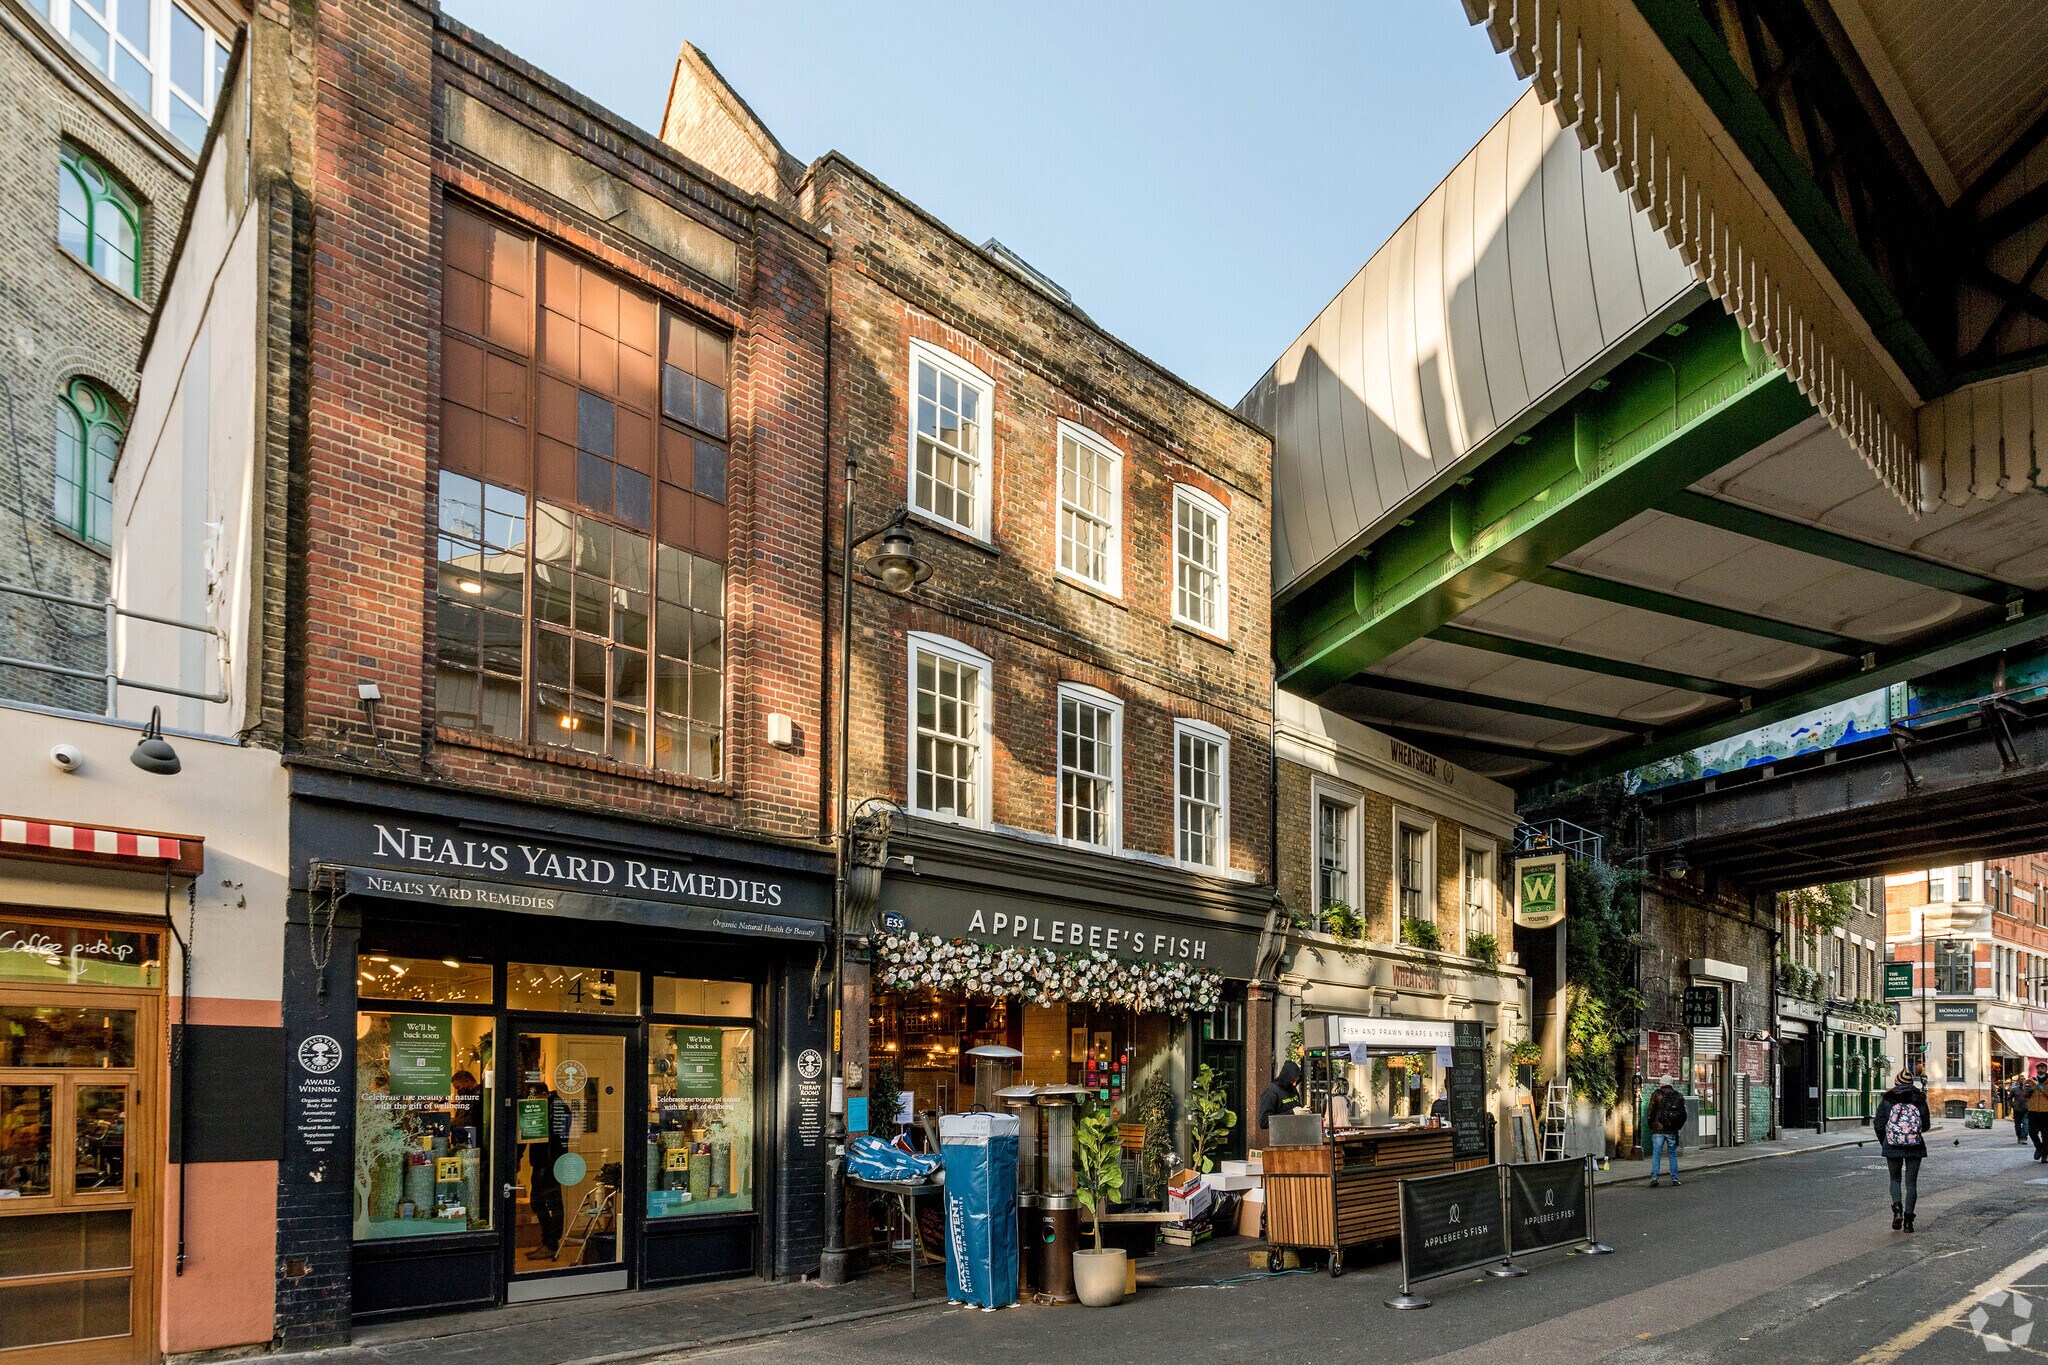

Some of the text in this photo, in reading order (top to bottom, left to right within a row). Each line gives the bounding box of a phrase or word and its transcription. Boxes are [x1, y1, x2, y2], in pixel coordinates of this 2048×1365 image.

[1391, 739, 1436, 776] WHEATSHEAF
[373, 824, 782, 906] NEAL'S YARD REMEDIES
[367, 876, 554, 910] NEAL'S YARD REMEDIES
[1524, 875, 1554, 902] W
[712, 919, 737, 928] Organic
[738, 922, 762, 931] Natural
[764, 924, 784, 933] Health
[794, 928, 814, 937] Beauty
[886, 918, 904, 928] ESS
[968, 910, 1206, 960] APPLEBEE'S FISH
[0, 930, 64, 958] Coffee
[567, 977, 586, 1003] 4
[404, 1031, 421, 1039] back
[409, 1102, 422, 1110] gift
[434, 1102, 470, 1110] wellbeing
[1524, 1210, 1575, 1226] APPLEBEE'S FISH
[951, 1196, 968, 1292] MASTERTENT
[962, 1242, 968, 1252] up
[1424, 1225, 1488, 1248] APPLEBEE'S FISH
[963, 1255, 972, 1293] building
